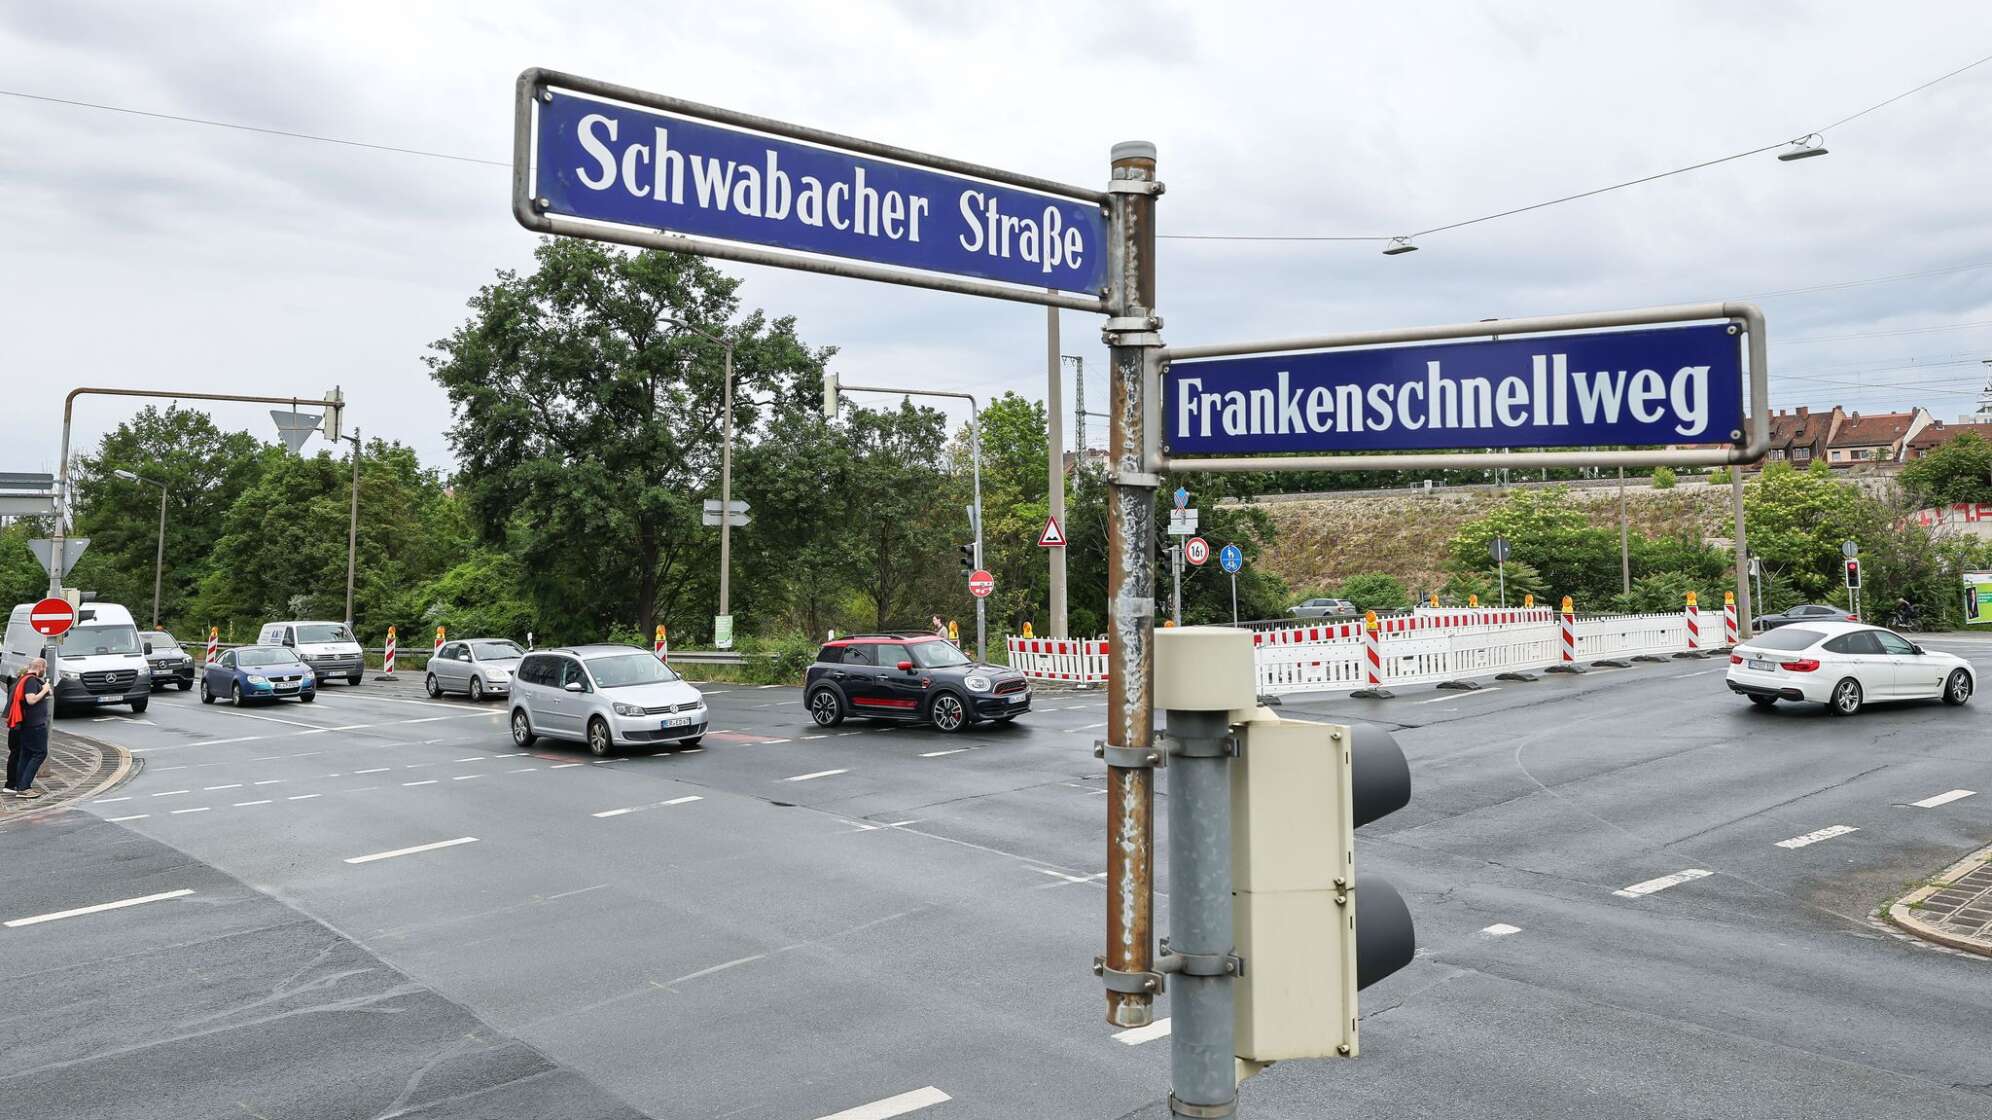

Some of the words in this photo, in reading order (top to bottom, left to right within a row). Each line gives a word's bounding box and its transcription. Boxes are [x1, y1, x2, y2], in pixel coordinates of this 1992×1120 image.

[576, 113, 928, 242] Schwabacher
[959, 190, 1083, 273] Straße
[1178, 353, 1711, 436] Frankenschnellweg
